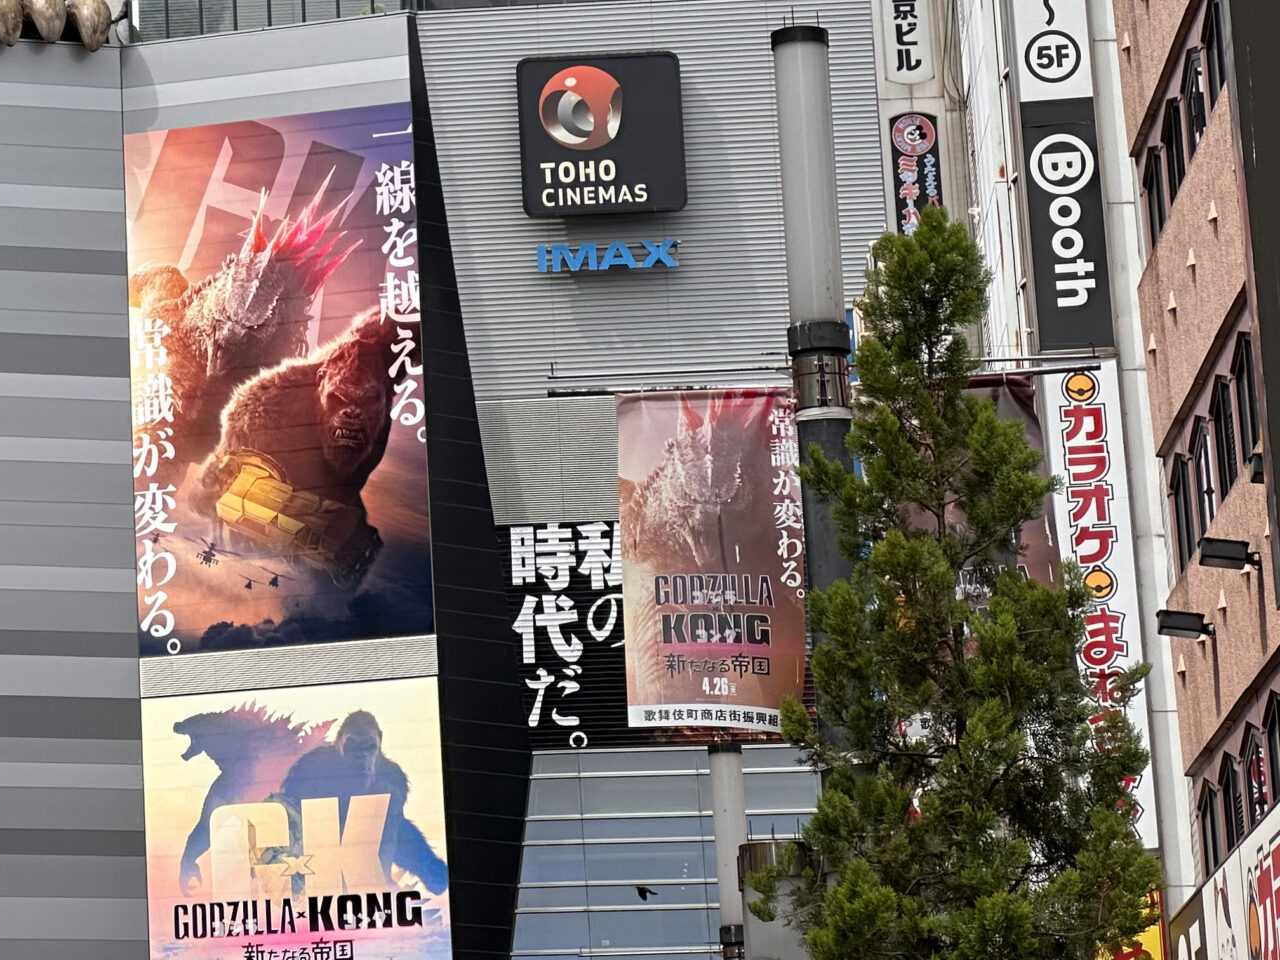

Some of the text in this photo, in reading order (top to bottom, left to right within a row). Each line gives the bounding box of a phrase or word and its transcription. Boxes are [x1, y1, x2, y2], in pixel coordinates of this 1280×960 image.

[1036, 45, 1070, 69] 5F
[540, 159, 616, 183] TOHO
[541, 183, 648, 207] CINEMAS
[1030, 133, 1096, 307] Booth
[536, 240, 680, 272] IMAX
[132, 317, 182, 656] 常識が変わる。
[1060, 404, 1119, 565] カラオケ
[654, 574, 775, 608] GODZILLA
[510, 523, 588, 747] 時代だ。
[661, 612, 772, 647] KONG
[664, 652, 770, 679] 新たなる帝国
[702, 677, 729, 696] 4.26
[644, 709, 780, 727] 歌舞伎町商店街振興組
[173, 896, 296, 940] GODZILLA
[308, 890, 424, 932] KONG
